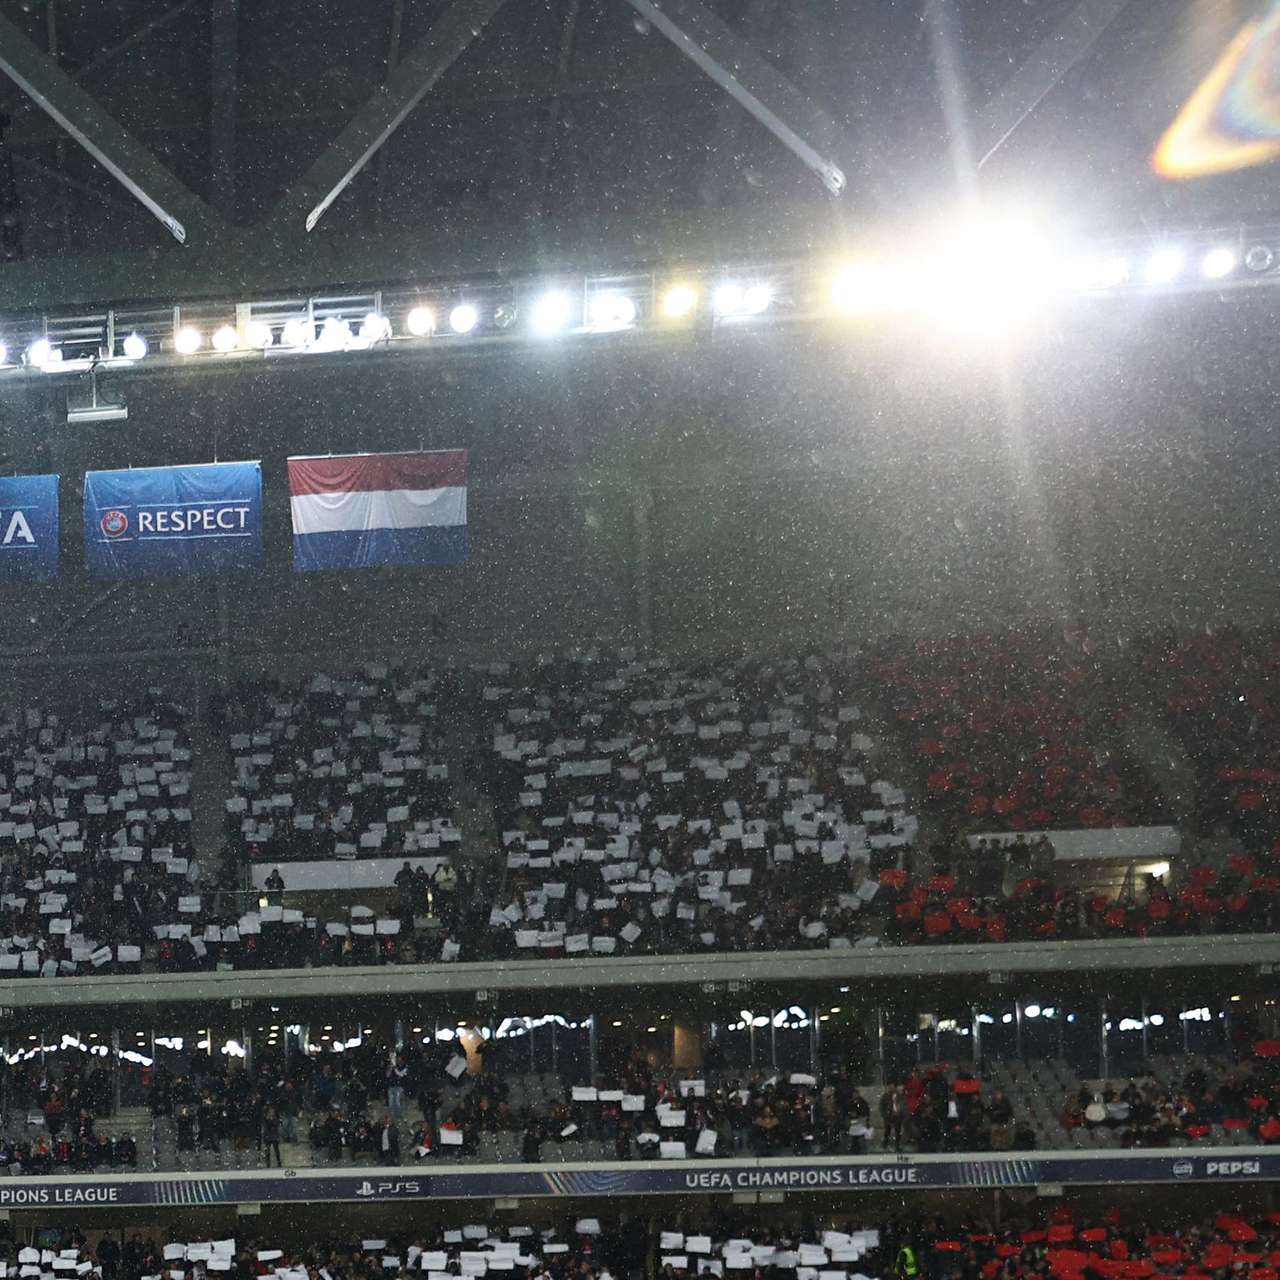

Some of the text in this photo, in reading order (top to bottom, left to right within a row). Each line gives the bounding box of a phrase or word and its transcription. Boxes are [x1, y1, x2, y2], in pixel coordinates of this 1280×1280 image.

[138, 508, 251, 533] RESPECT
[1206, 1161, 1260, 1175] PEPSI
[685, 1168, 917, 1187] UEFA CHAMPIONS LEAGUE
[55, 1187, 118, 1202] LEAGUE
[378, 1181, 420, 1193] PS5
